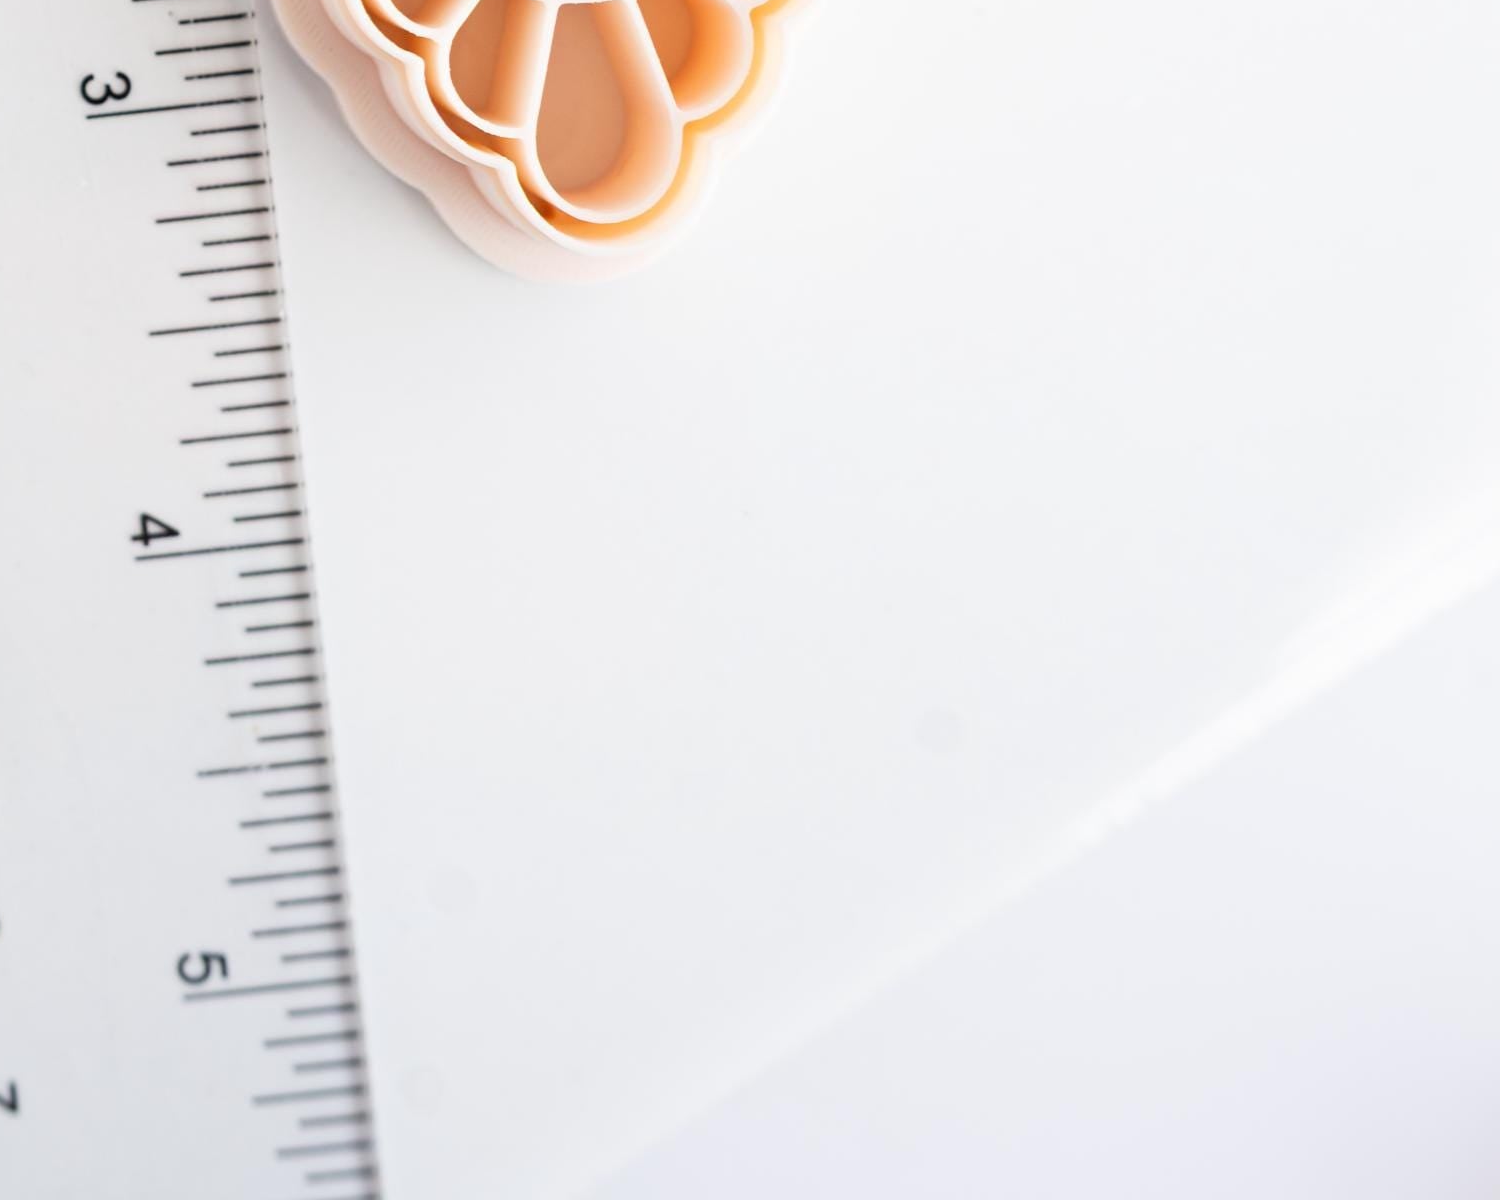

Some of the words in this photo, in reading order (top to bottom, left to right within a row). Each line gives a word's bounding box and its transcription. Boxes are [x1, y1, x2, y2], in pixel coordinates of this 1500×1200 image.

[77, 69, 134, 107] 3
[129, 511, 182, 548] 4
[175, 950, 231, 986] 5
